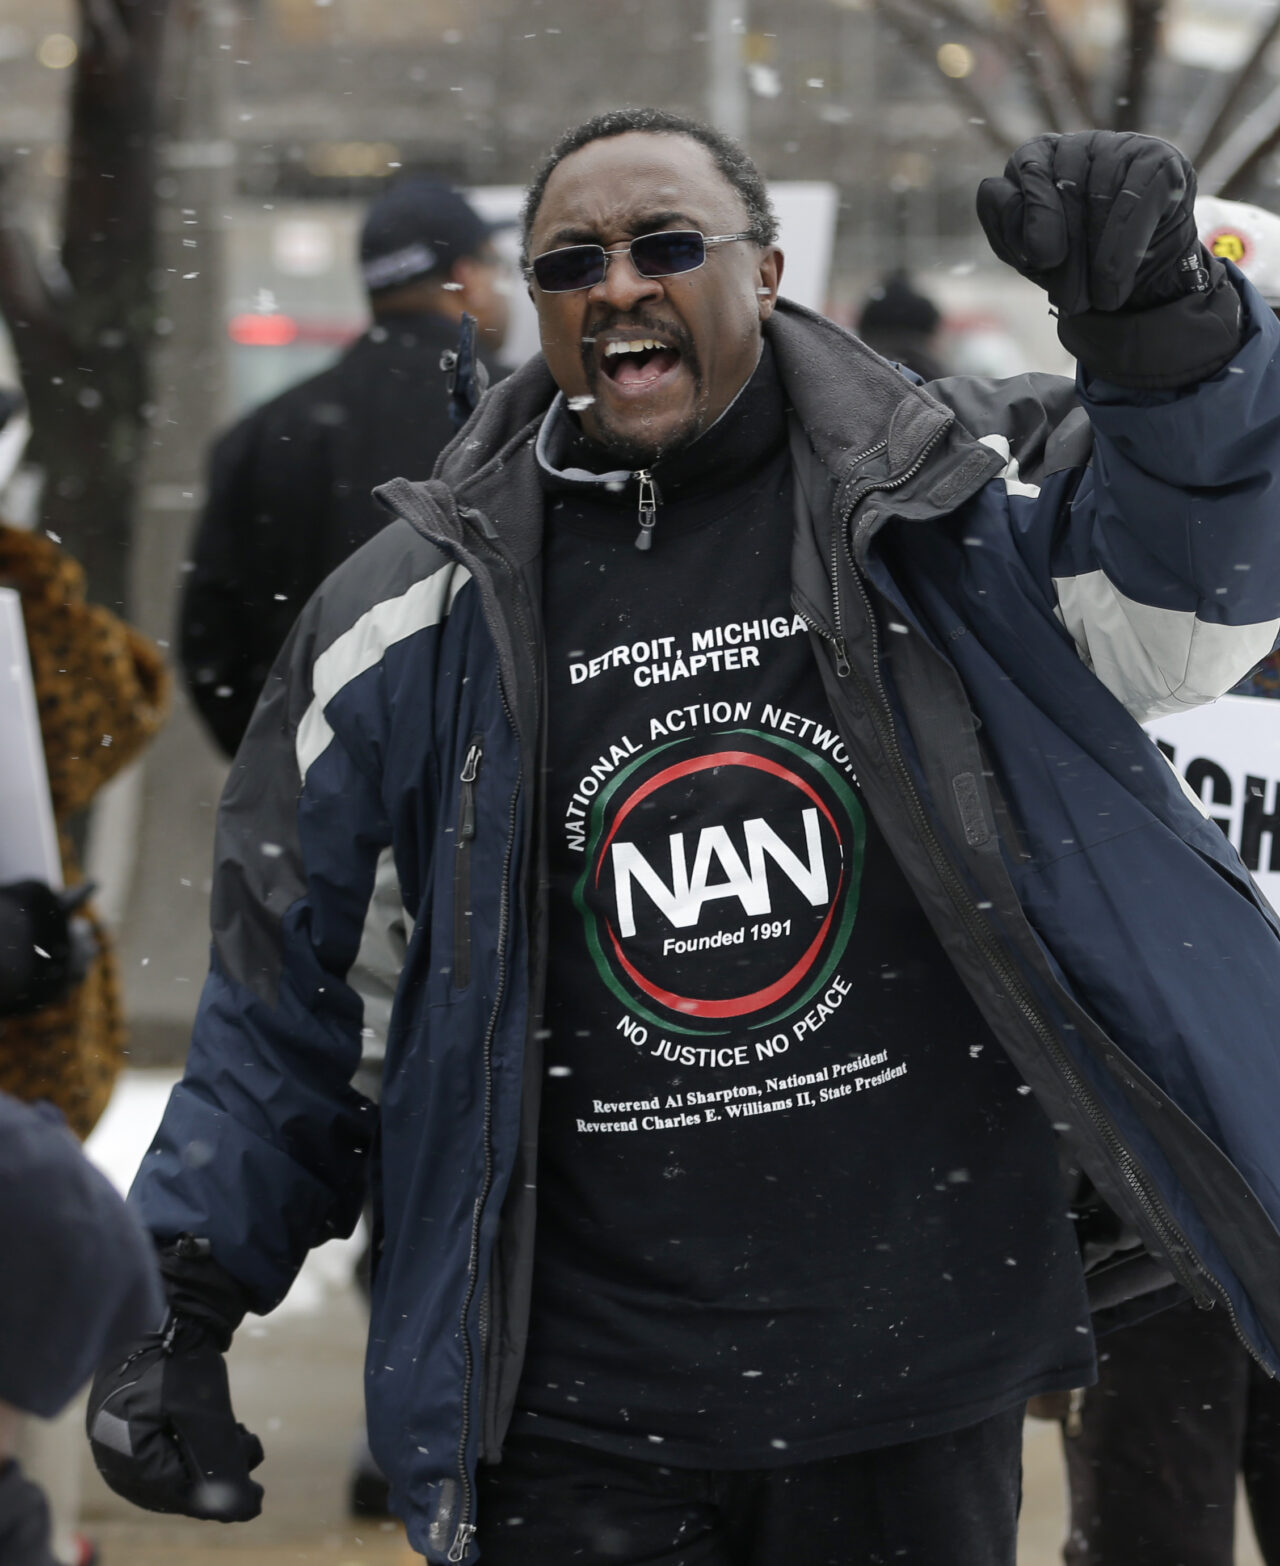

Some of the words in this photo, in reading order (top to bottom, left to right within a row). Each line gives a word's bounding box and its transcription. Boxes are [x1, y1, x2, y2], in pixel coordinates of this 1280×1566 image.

[568, 636, 682, 685] DETROIT,
[692, 614, 809, 652] MICHIGA
[633, 646, 760, 687] CHAPTER
[565, 734, 643, 851] NATIONAL
[650, 702, 752, 740] ACTION
[761, 704, 860, 787] NETWO
[611, 807, 829, 938] NAN
[662, 927, 744, 956] Founded
[749, 920, 792, 941] 1991
[616, 1015, 648, 1046] NO
[651, 1039, 750, 1067] JUSTICE
[755, 1034, 790, 1061] NO
[792, 975, 853, 1042] PEACE
[576, 1117, 638, 1132] Reverend
[641, 1112, 701, 1131] Charles
[704, 1109, 722, 1123] E.
[725, 1098, 793, 1119] Williams
[796, 1091, 816, 1107] II,
[819, 1084, 852, 1103] State
[854, 1061, 908, 1092] President
[592, 1097, 660, 1113] Reverend
[665, 1093, 683, 1108] Al
[686, 1084, 763, 1107] Sharpton,
[765, 1067, 829, 1092] National
[832, 1048, 888, 1078] President
